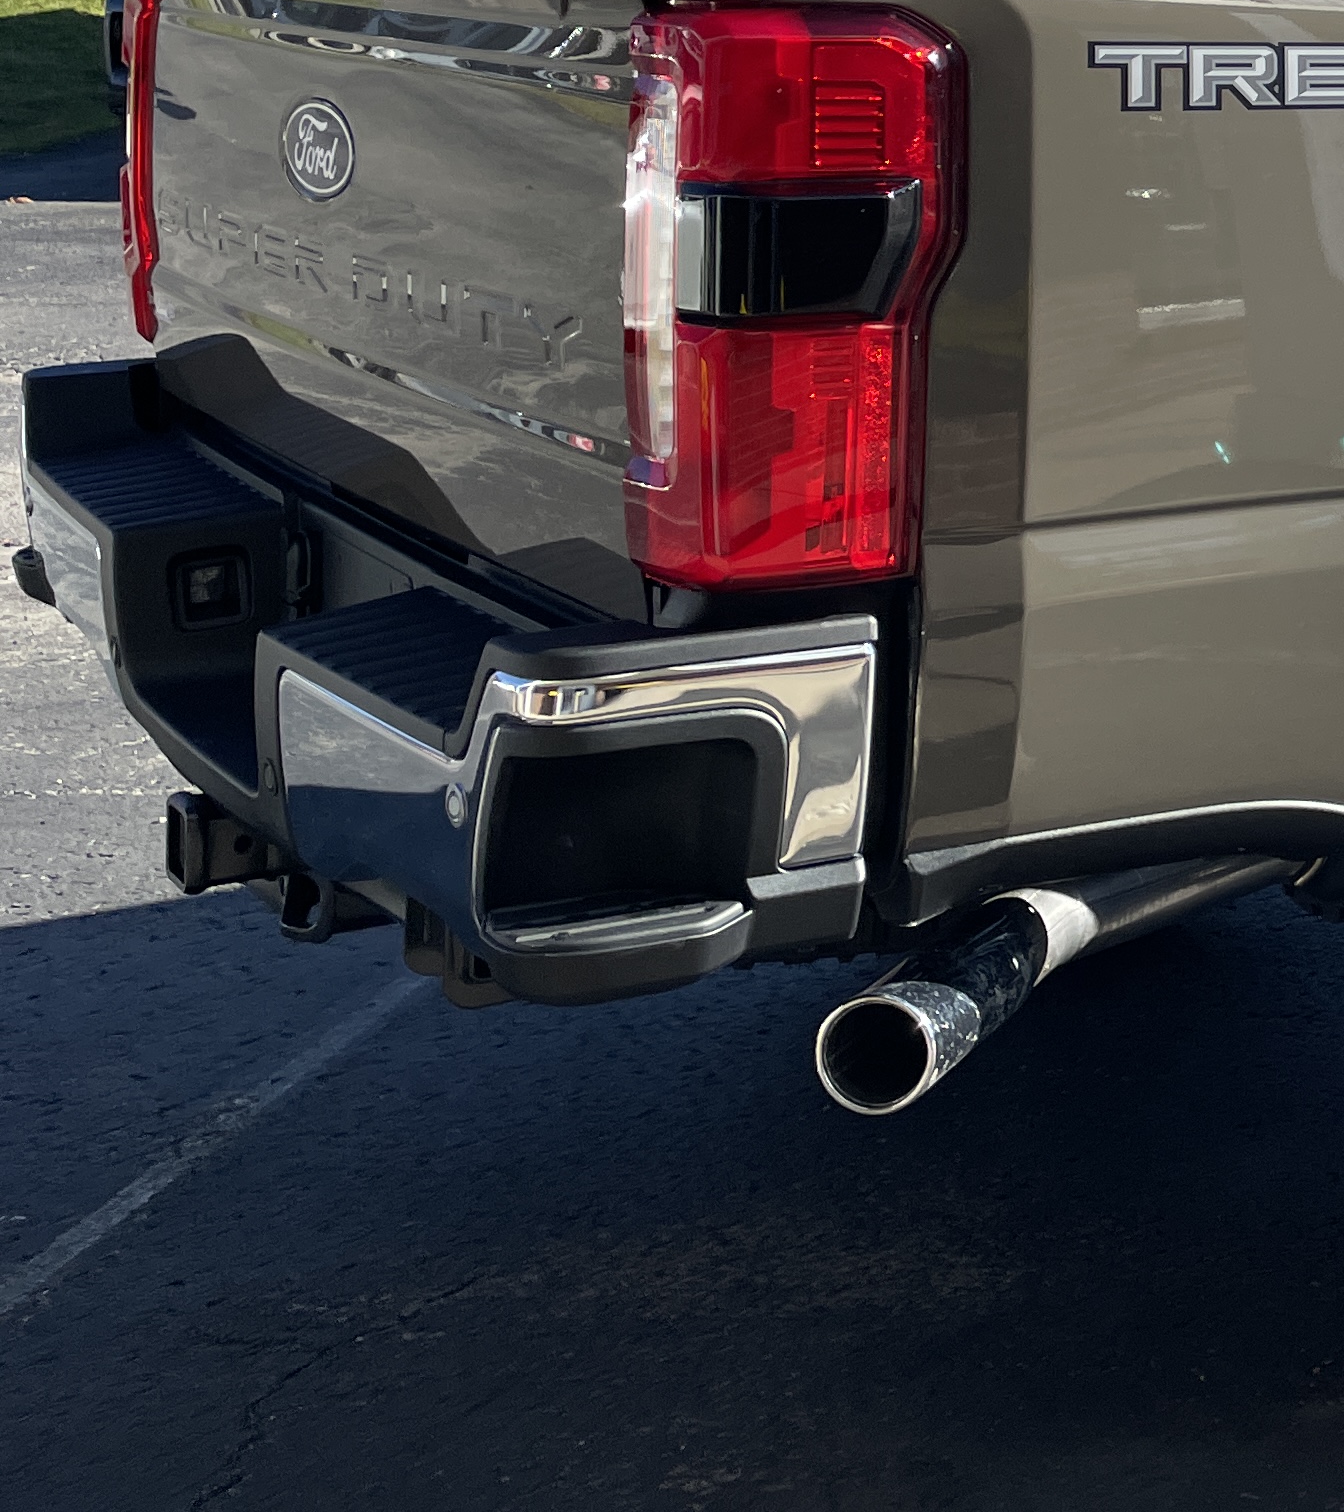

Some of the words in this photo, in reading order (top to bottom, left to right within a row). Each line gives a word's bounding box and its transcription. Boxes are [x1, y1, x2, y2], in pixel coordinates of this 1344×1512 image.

[294, 113, 339, 180] Ford
[157, 187, 330, 294] SUPER
[350, 252, 584, 370] DUTY
